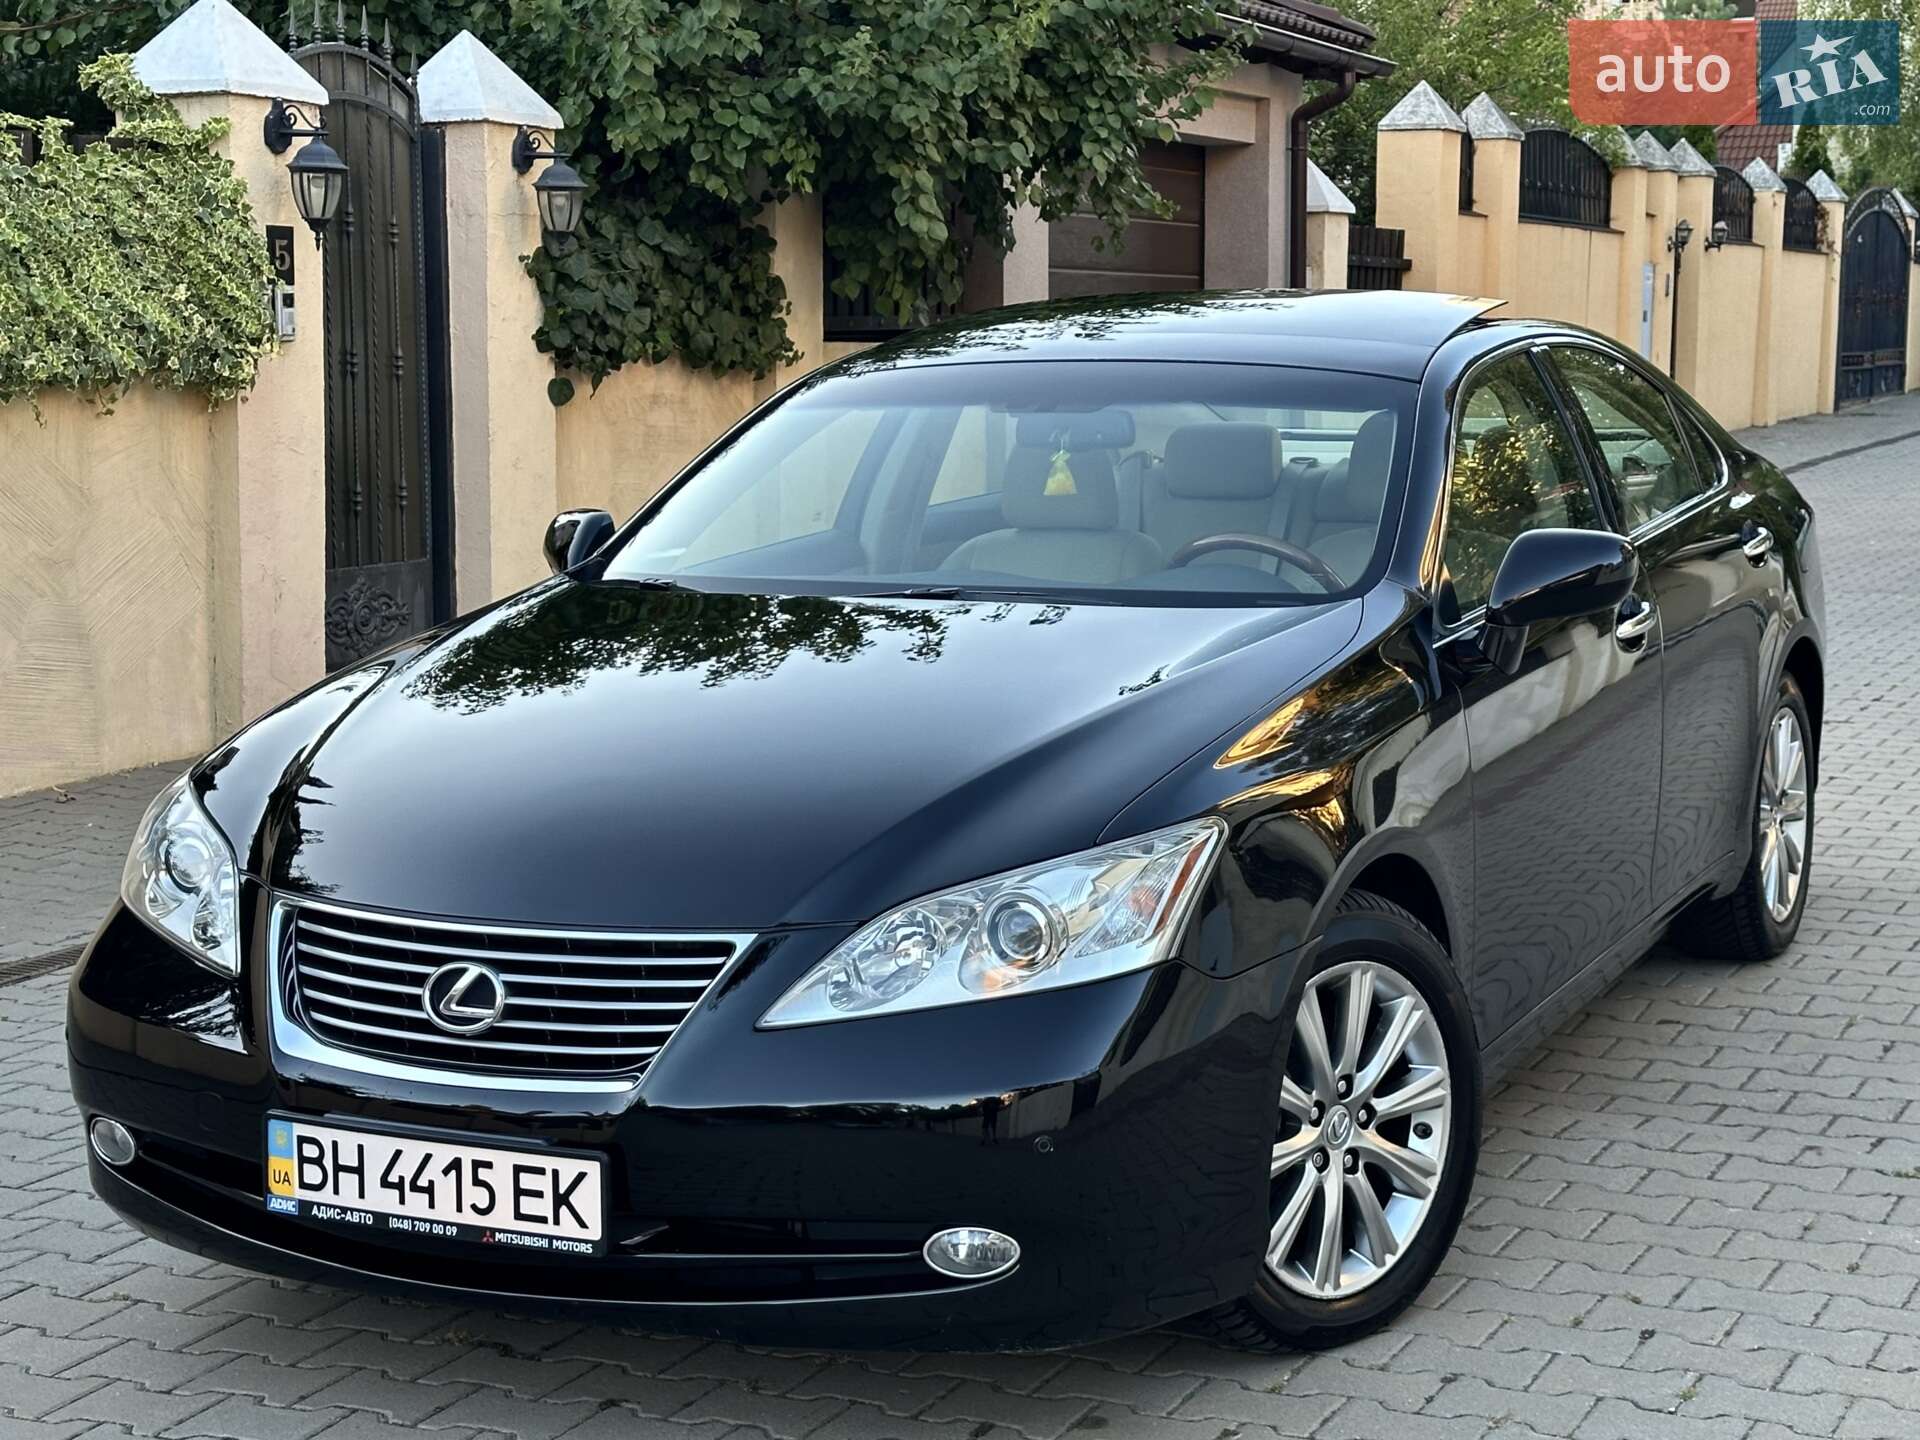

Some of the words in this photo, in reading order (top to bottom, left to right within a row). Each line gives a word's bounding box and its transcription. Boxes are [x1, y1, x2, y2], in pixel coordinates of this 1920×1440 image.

[275, 238, 291, 271] 5
[272, 1168, 292, 1186] UA
[379, 1148, 497, 1217] 4415
[311, 1204, 374, 1225] АДИС-АВТО
[388, 1216, 412, 1231] (048)
[414, 1220, 431, 1233] 709
[432, 1224, 444, 1235] 00
[445, 1225, 458, 1237] 09
[495, 1231, 549, 1249] MITSUBISHI
[552, 1239, 593, 1254] MOTORS
